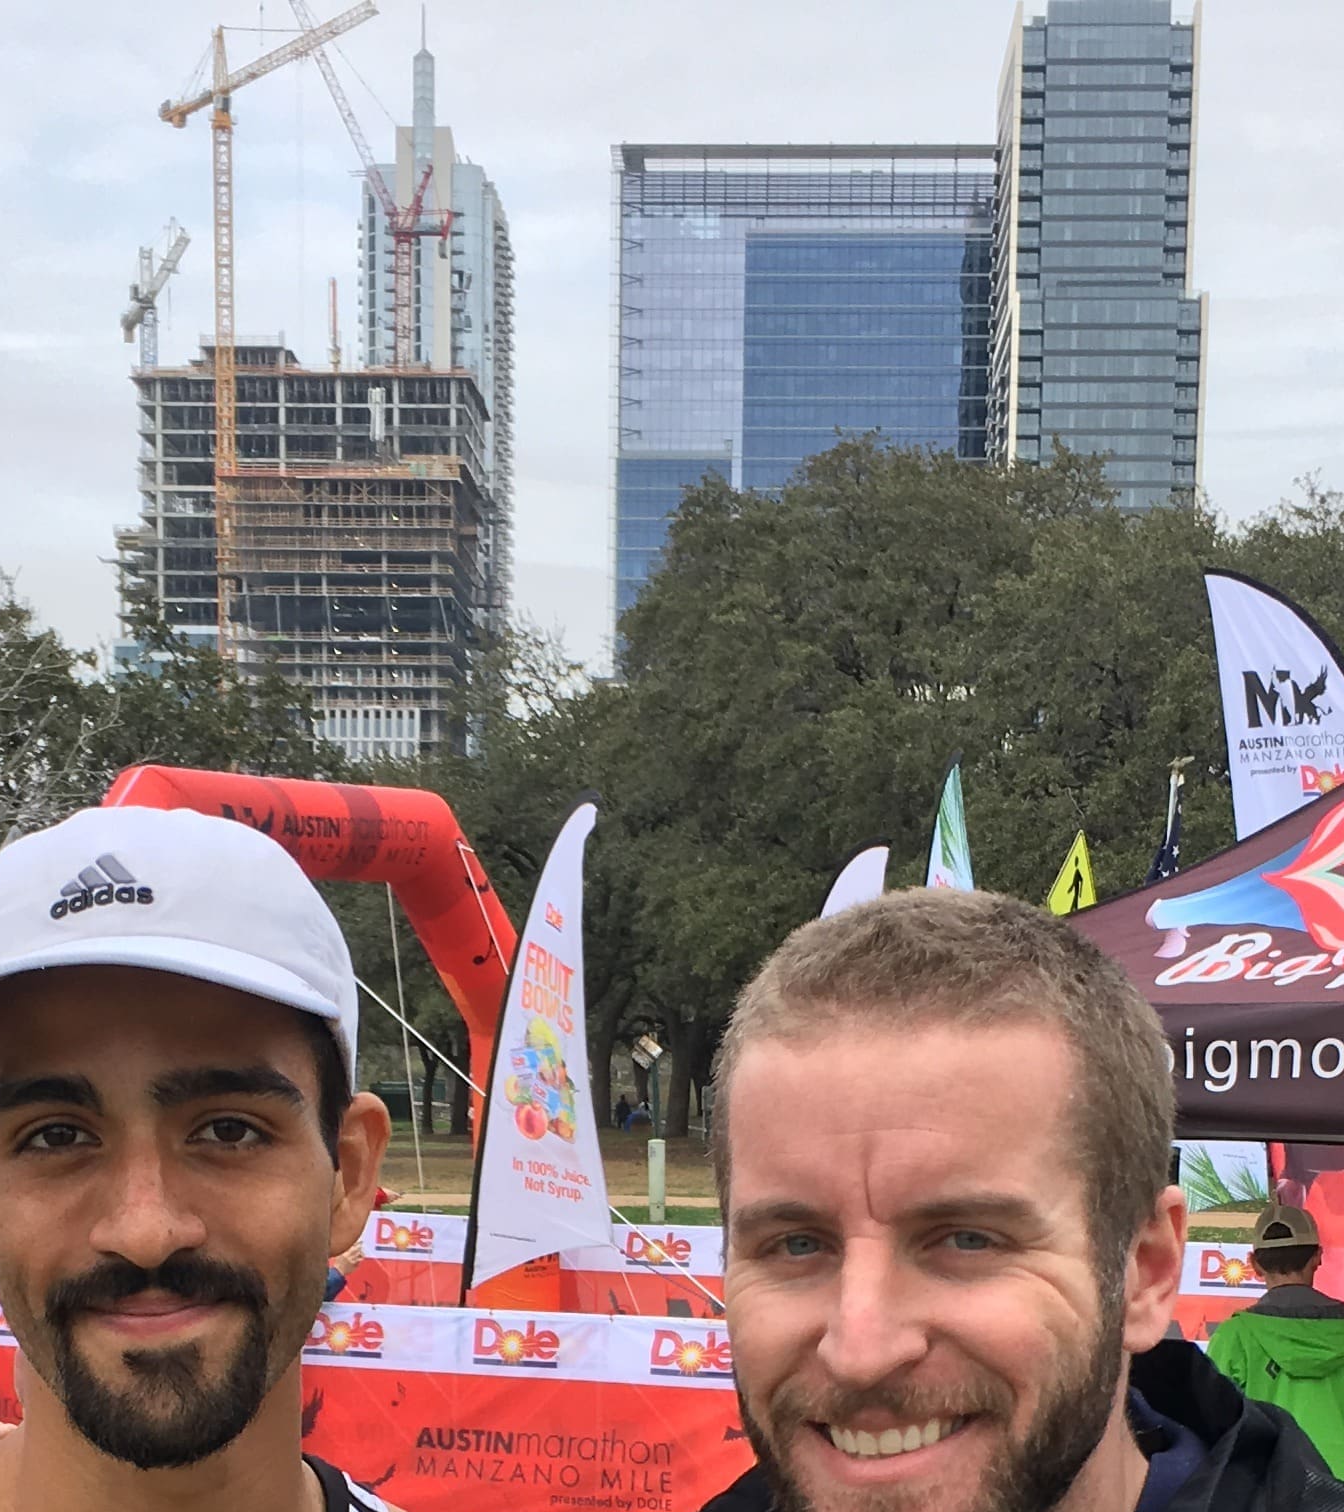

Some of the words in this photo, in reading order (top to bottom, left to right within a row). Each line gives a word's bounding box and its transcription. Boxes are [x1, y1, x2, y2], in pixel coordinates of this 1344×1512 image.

[1240, 749, 1315, 764] MANZANO
[50, 883, 155, 920] adidas
[524, 941, 576, 1002] FRUIT
[513, 1157, 524, 1172] In
[528, 1159, 559, 1178] 100%
[524, 1176, 545, 1193] Not
[547, 1181, 584, 1203] Syrup.
[375, 1217, 434, 1249] Dole
[626, 1231, 692, 1263] Dole
[473, 1318, 560, 1363] Dole
[415, 1456, 580, 1488] MANZANO
[600, 1469, 672, 1494] MILE
[549, 1494, 612, 1507] presented
[615, 1495, 632, 1512] by
[636, 1497, 672, 1511] DOLE
